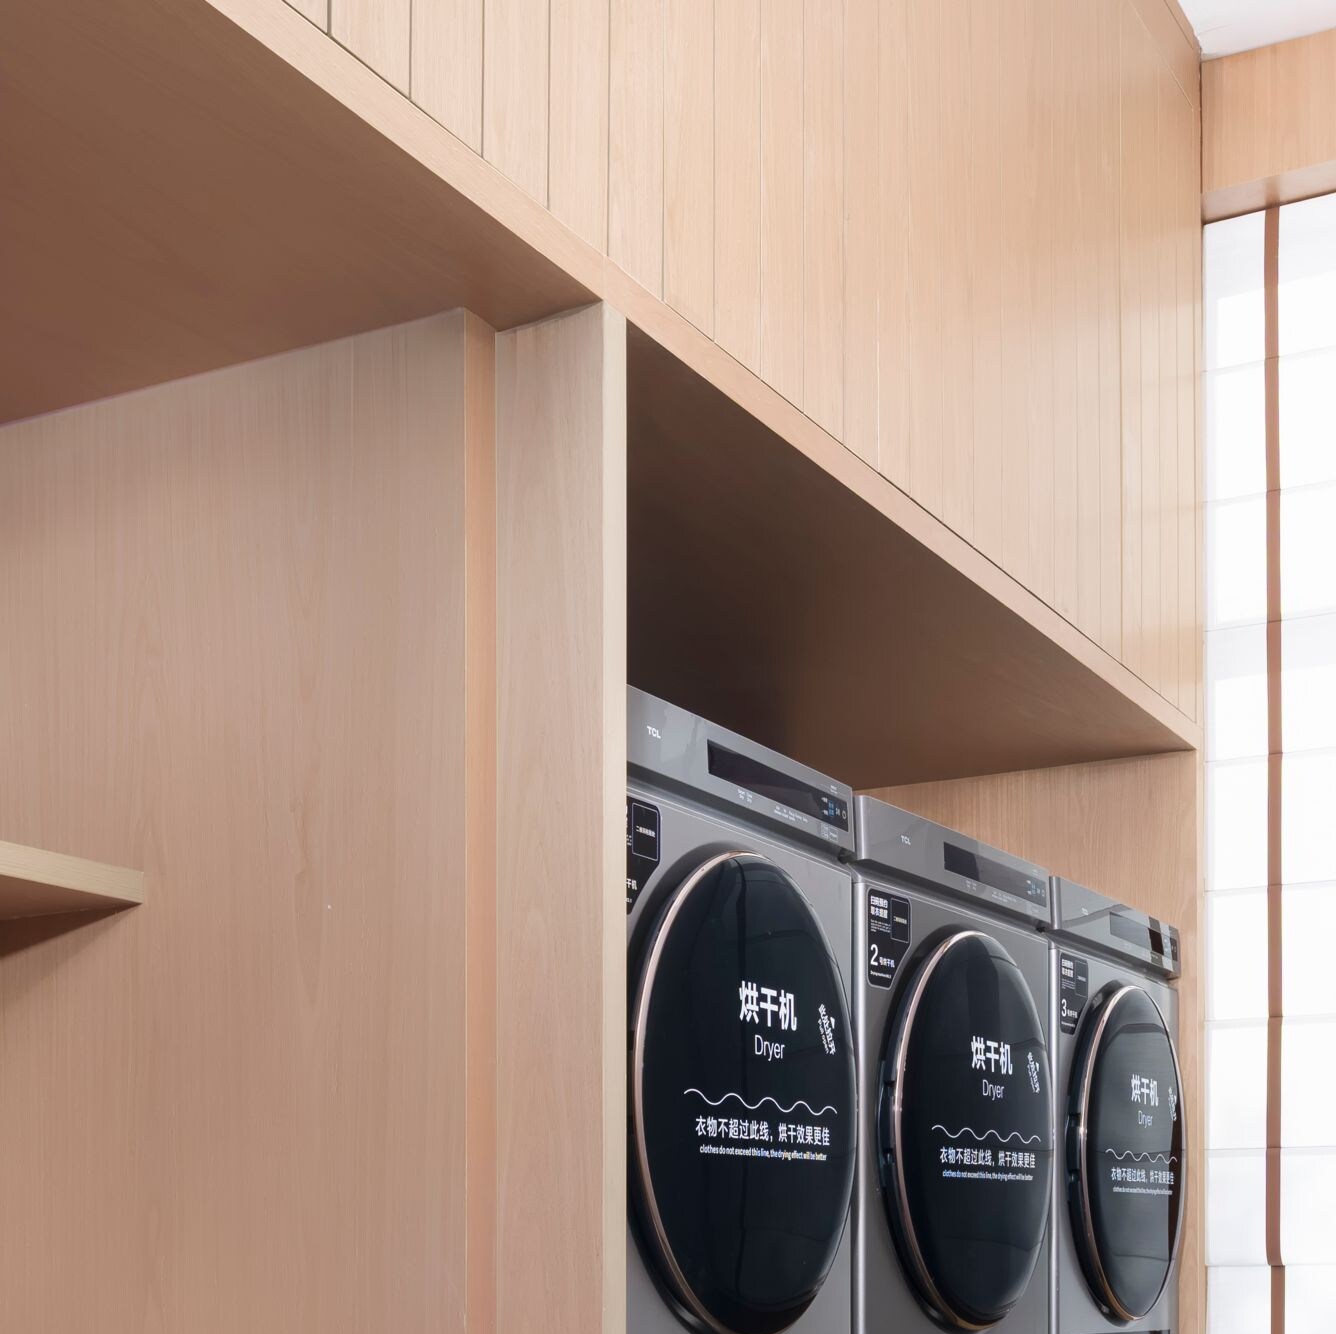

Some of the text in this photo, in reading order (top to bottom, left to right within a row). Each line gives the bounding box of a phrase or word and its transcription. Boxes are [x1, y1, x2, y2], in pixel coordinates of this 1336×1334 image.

[647, 726, 661, 739] TCL
[901, 835, 911, 845] TCL
[870, 944, 878, 966] 2
[738, 980, 797, 1031] 烘干机
[1062, 999, 1067, 1017] 3
[754, 1034, 785, 1061] Dryer
[970, 1036, 1013, 1075] 烘干机
[982, 1080, 1004, 1100] Dryer
[1131, 1074, 1158, 1107] 烘干机
[1138, 1110, 1152, 1128] Dryer
[696, 1116, 830, 1146] 衣物不超过此线，烘干效果更佳
[700, 1144, 718, 1154] clothes
[719, 1146, 725, 1154] do
[726, 1147, 734, 1155] not
[735, 1147, 751, 1156] exceed
[752, 1148, 761, 1157] this
[778, 1150, 792, 1160] drying
[792, 1150, 804, 1160] effect
